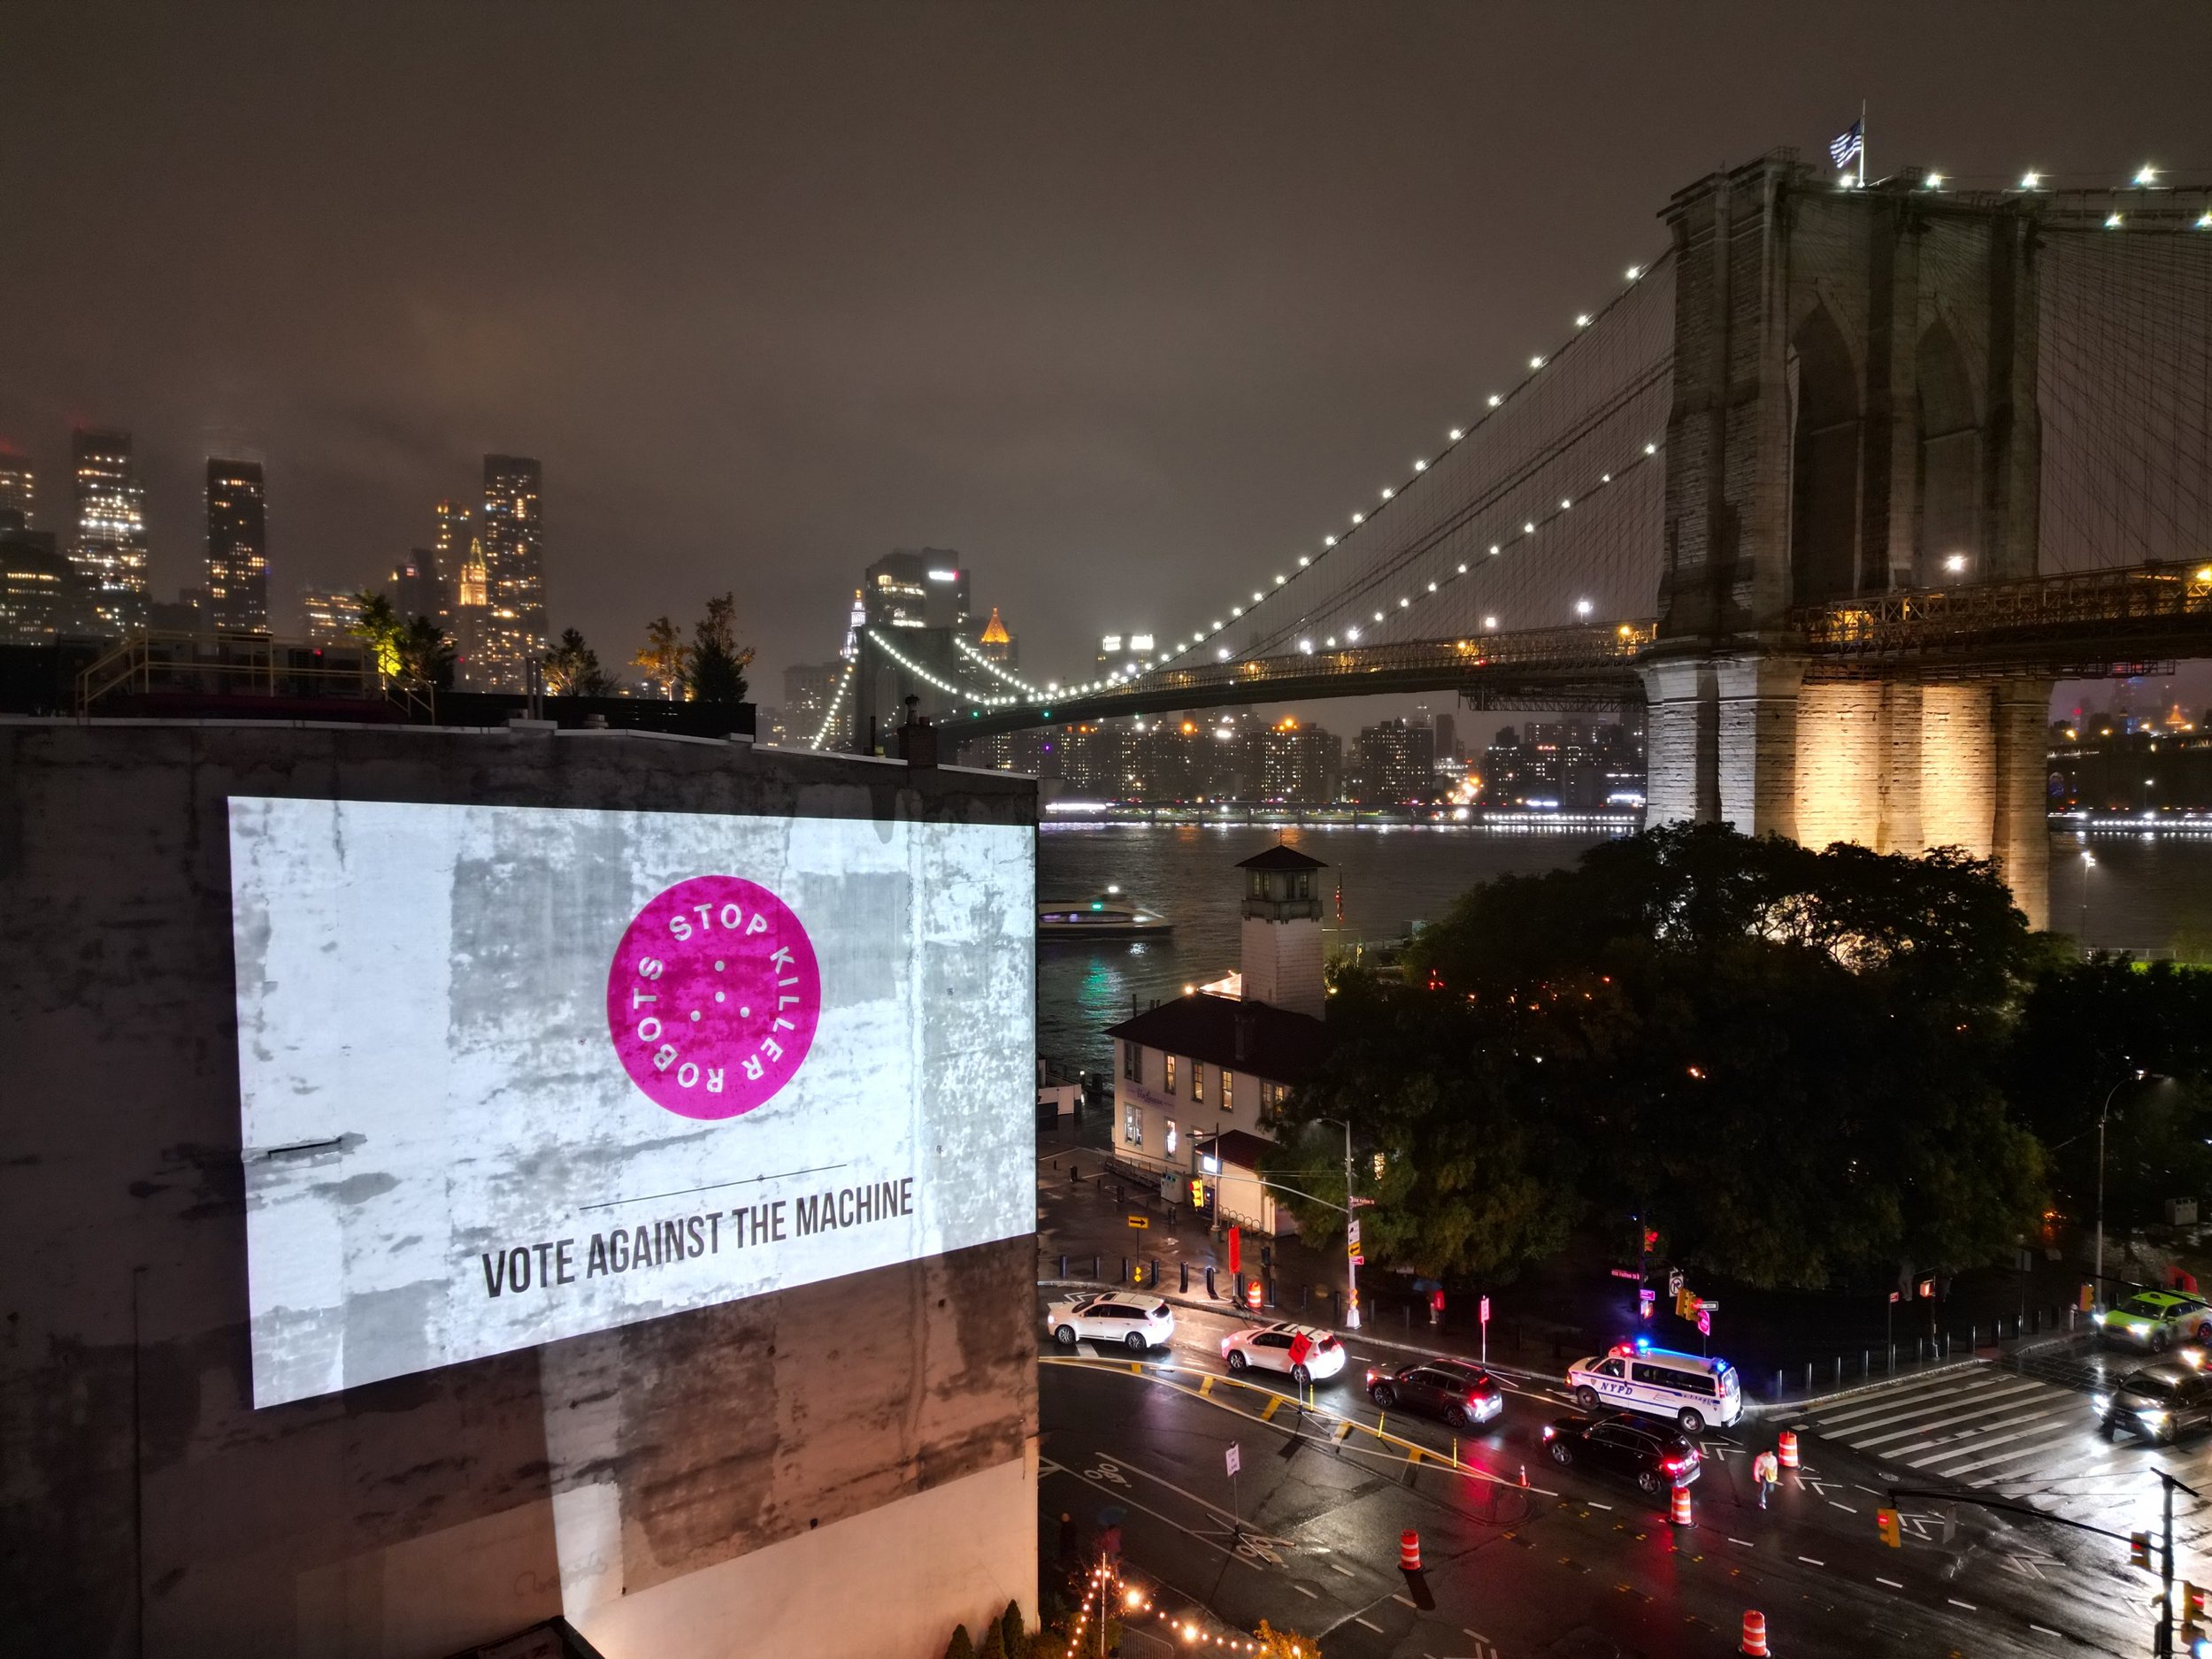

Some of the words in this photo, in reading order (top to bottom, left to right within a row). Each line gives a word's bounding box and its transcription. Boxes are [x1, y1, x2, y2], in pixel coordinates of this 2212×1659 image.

[669, 903, 767, 941] STOP
[633, 956, 725, 1093] ROBOTS
[741, 946, 800, 1080] KILLER
[482, 1238, 575, 1298] VOTE
[587, 1211, 723, 1279] AGAINST
[732, 1200, 787, 1257] THE
[796, 1177, 913, 1237] MACHINE
[1601, 1382, 1633, 1395] NYPD
